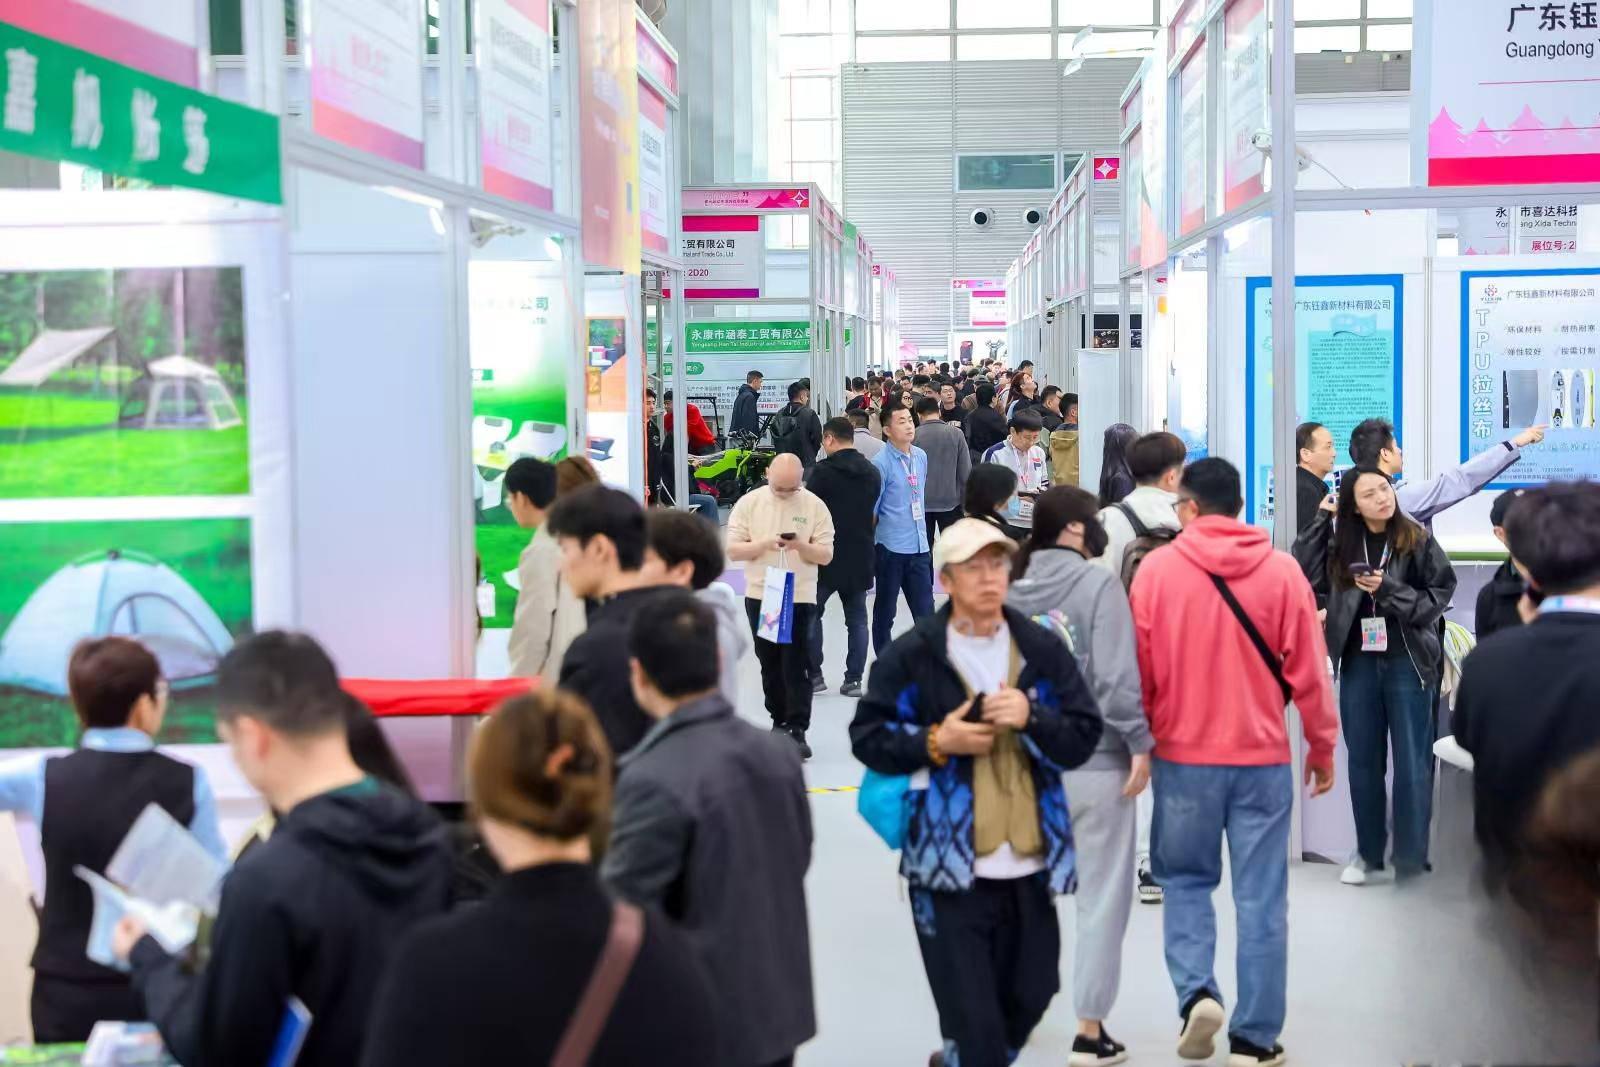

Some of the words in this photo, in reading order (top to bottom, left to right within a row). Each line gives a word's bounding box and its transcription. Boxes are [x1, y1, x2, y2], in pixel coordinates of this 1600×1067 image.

[1507, 2, 1598, 32] 广东钰
[1505, 40, 1594, 60] Guangdong
[688, 268, 709, 277] 2D20
